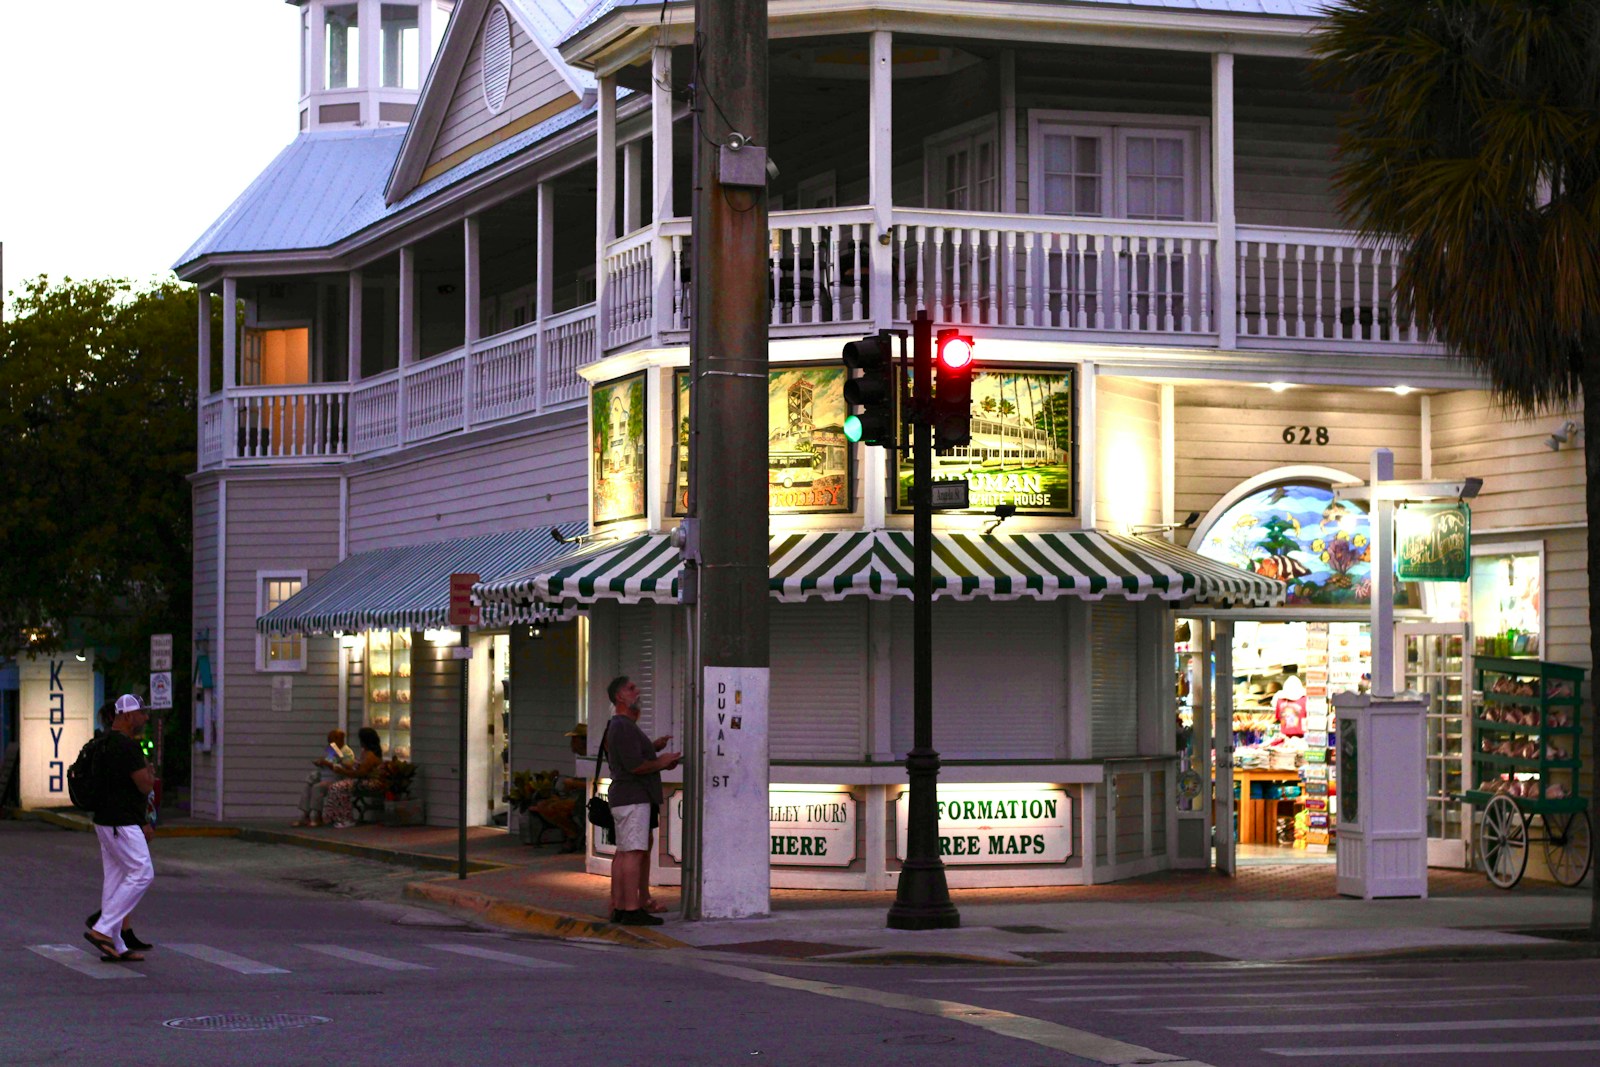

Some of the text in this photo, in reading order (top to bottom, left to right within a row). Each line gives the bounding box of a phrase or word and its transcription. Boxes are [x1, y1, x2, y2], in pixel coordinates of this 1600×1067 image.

[1282, 425, 1329, 446] 628
[969, 493, 1052, 506] WHITE HOUSE
[717, 682, 726, 756] DUVAL
[712, 776, 729, 788] ST
[769, 802, 847, 823] LLEY TOURS
[937, 799, 1058, 821] FORMATION
[771, 835, 828, 857] HERE
[938, 834, 1046, 856] REE MAPS
